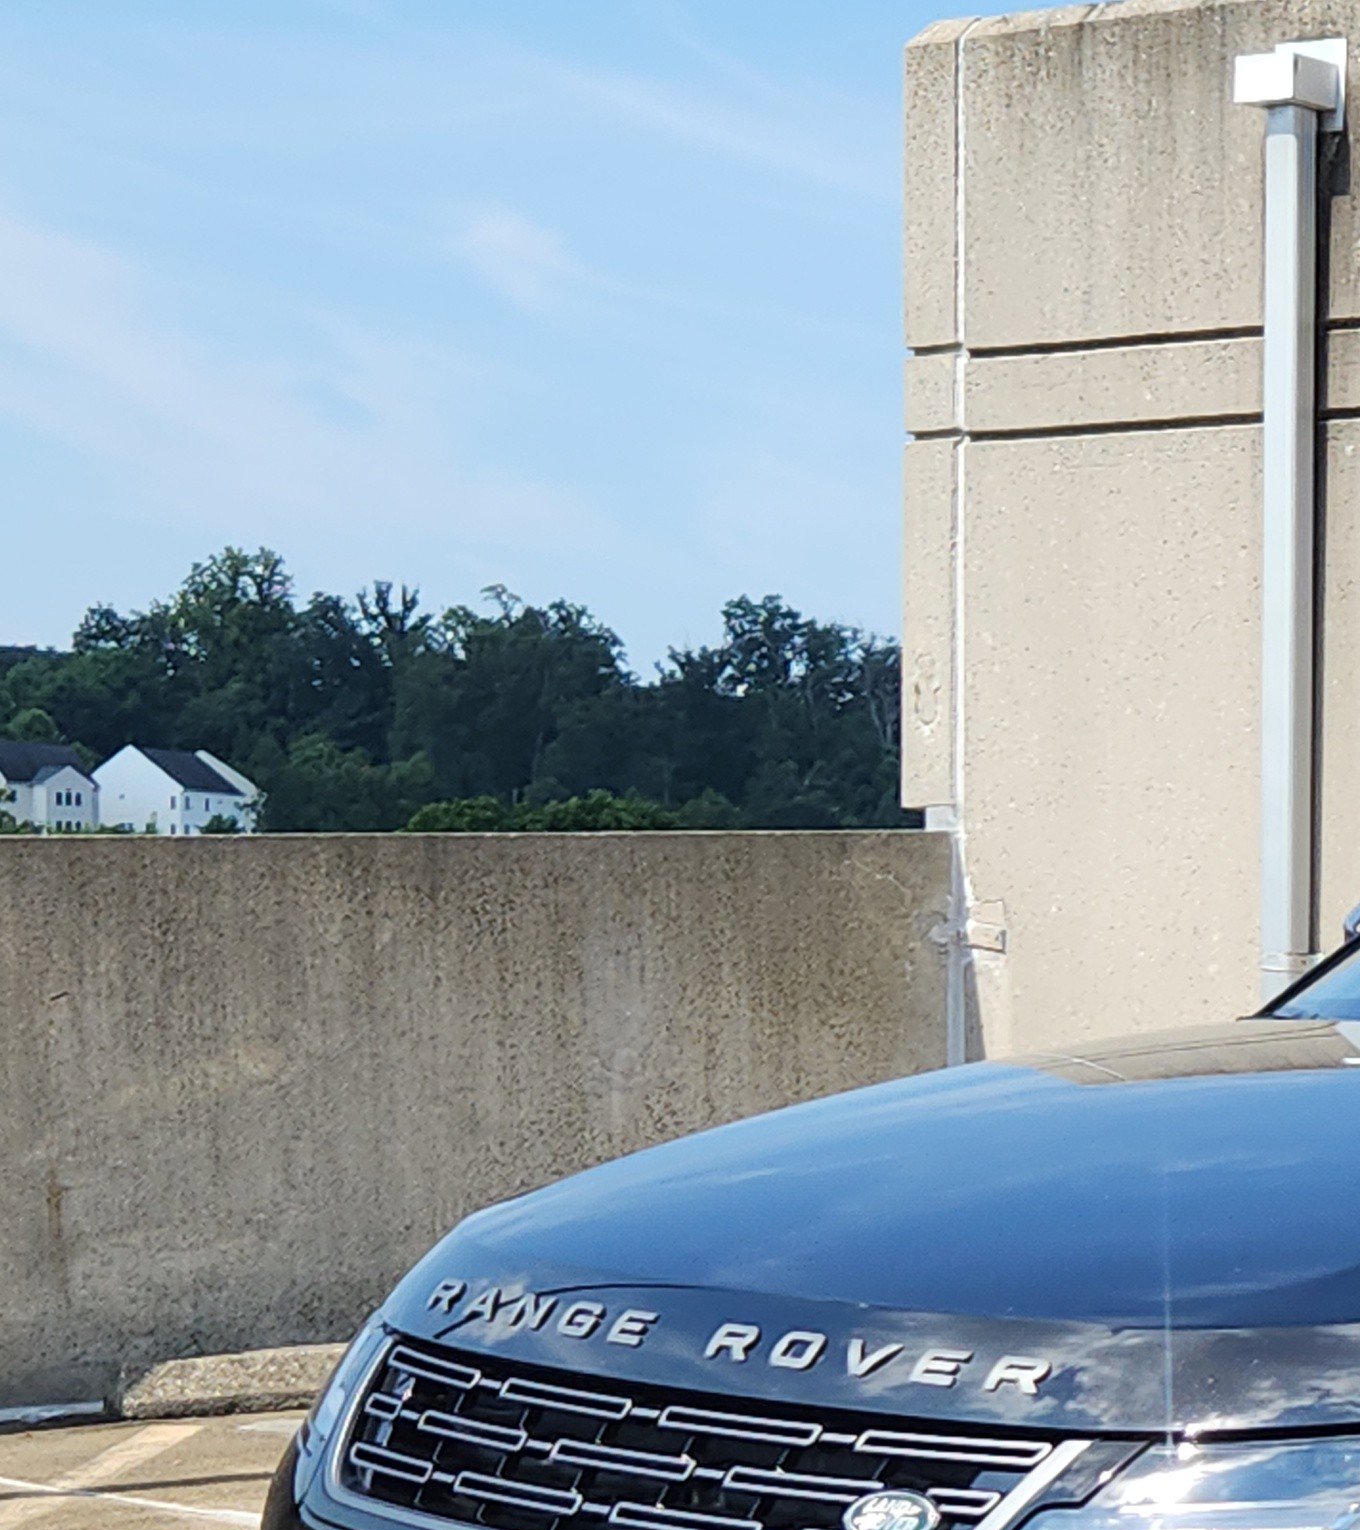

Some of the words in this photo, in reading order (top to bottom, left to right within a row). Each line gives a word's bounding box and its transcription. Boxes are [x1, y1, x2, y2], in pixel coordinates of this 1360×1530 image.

[425, 1277, 658, 1348] RANGE
[704, 1322, 1054, 1395] ROVER
[861, 1497, 923, 1517] LAND
